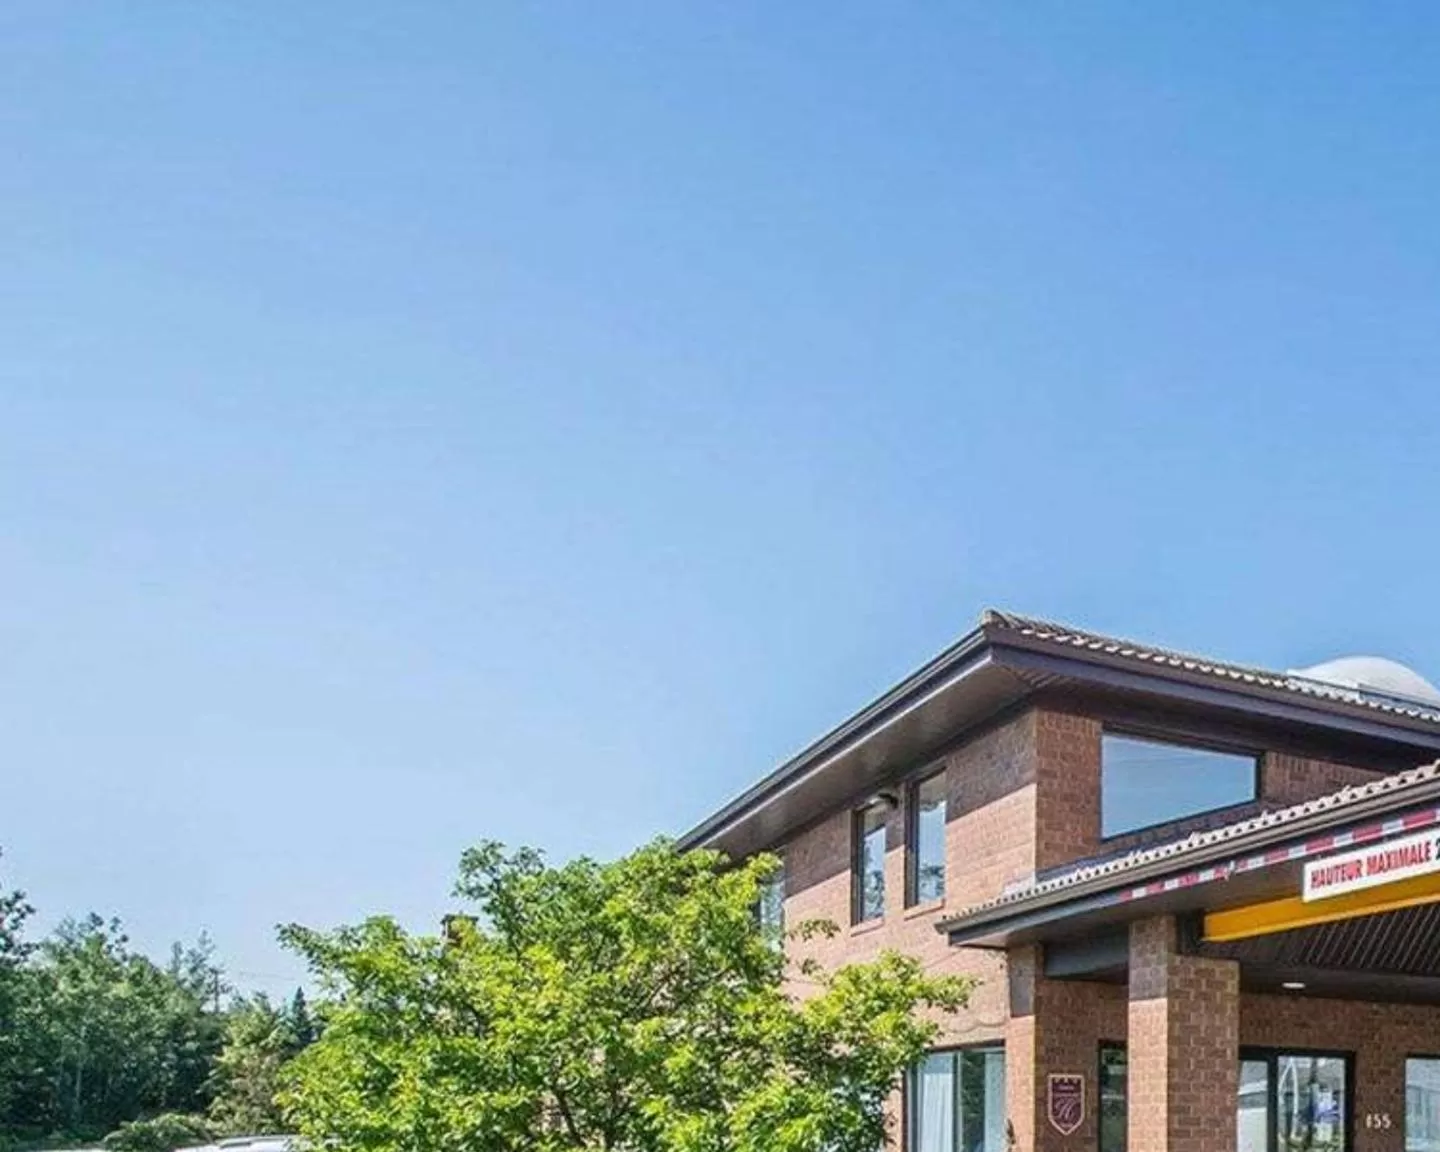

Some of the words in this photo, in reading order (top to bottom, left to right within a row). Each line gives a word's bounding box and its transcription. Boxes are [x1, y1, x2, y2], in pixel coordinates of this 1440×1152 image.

[1310, 859, 1363, 889] HAUTEUR
[1366, 840, 1432, 877] MAXIMALE
[1365, 1112, 1392, 1129] 155
